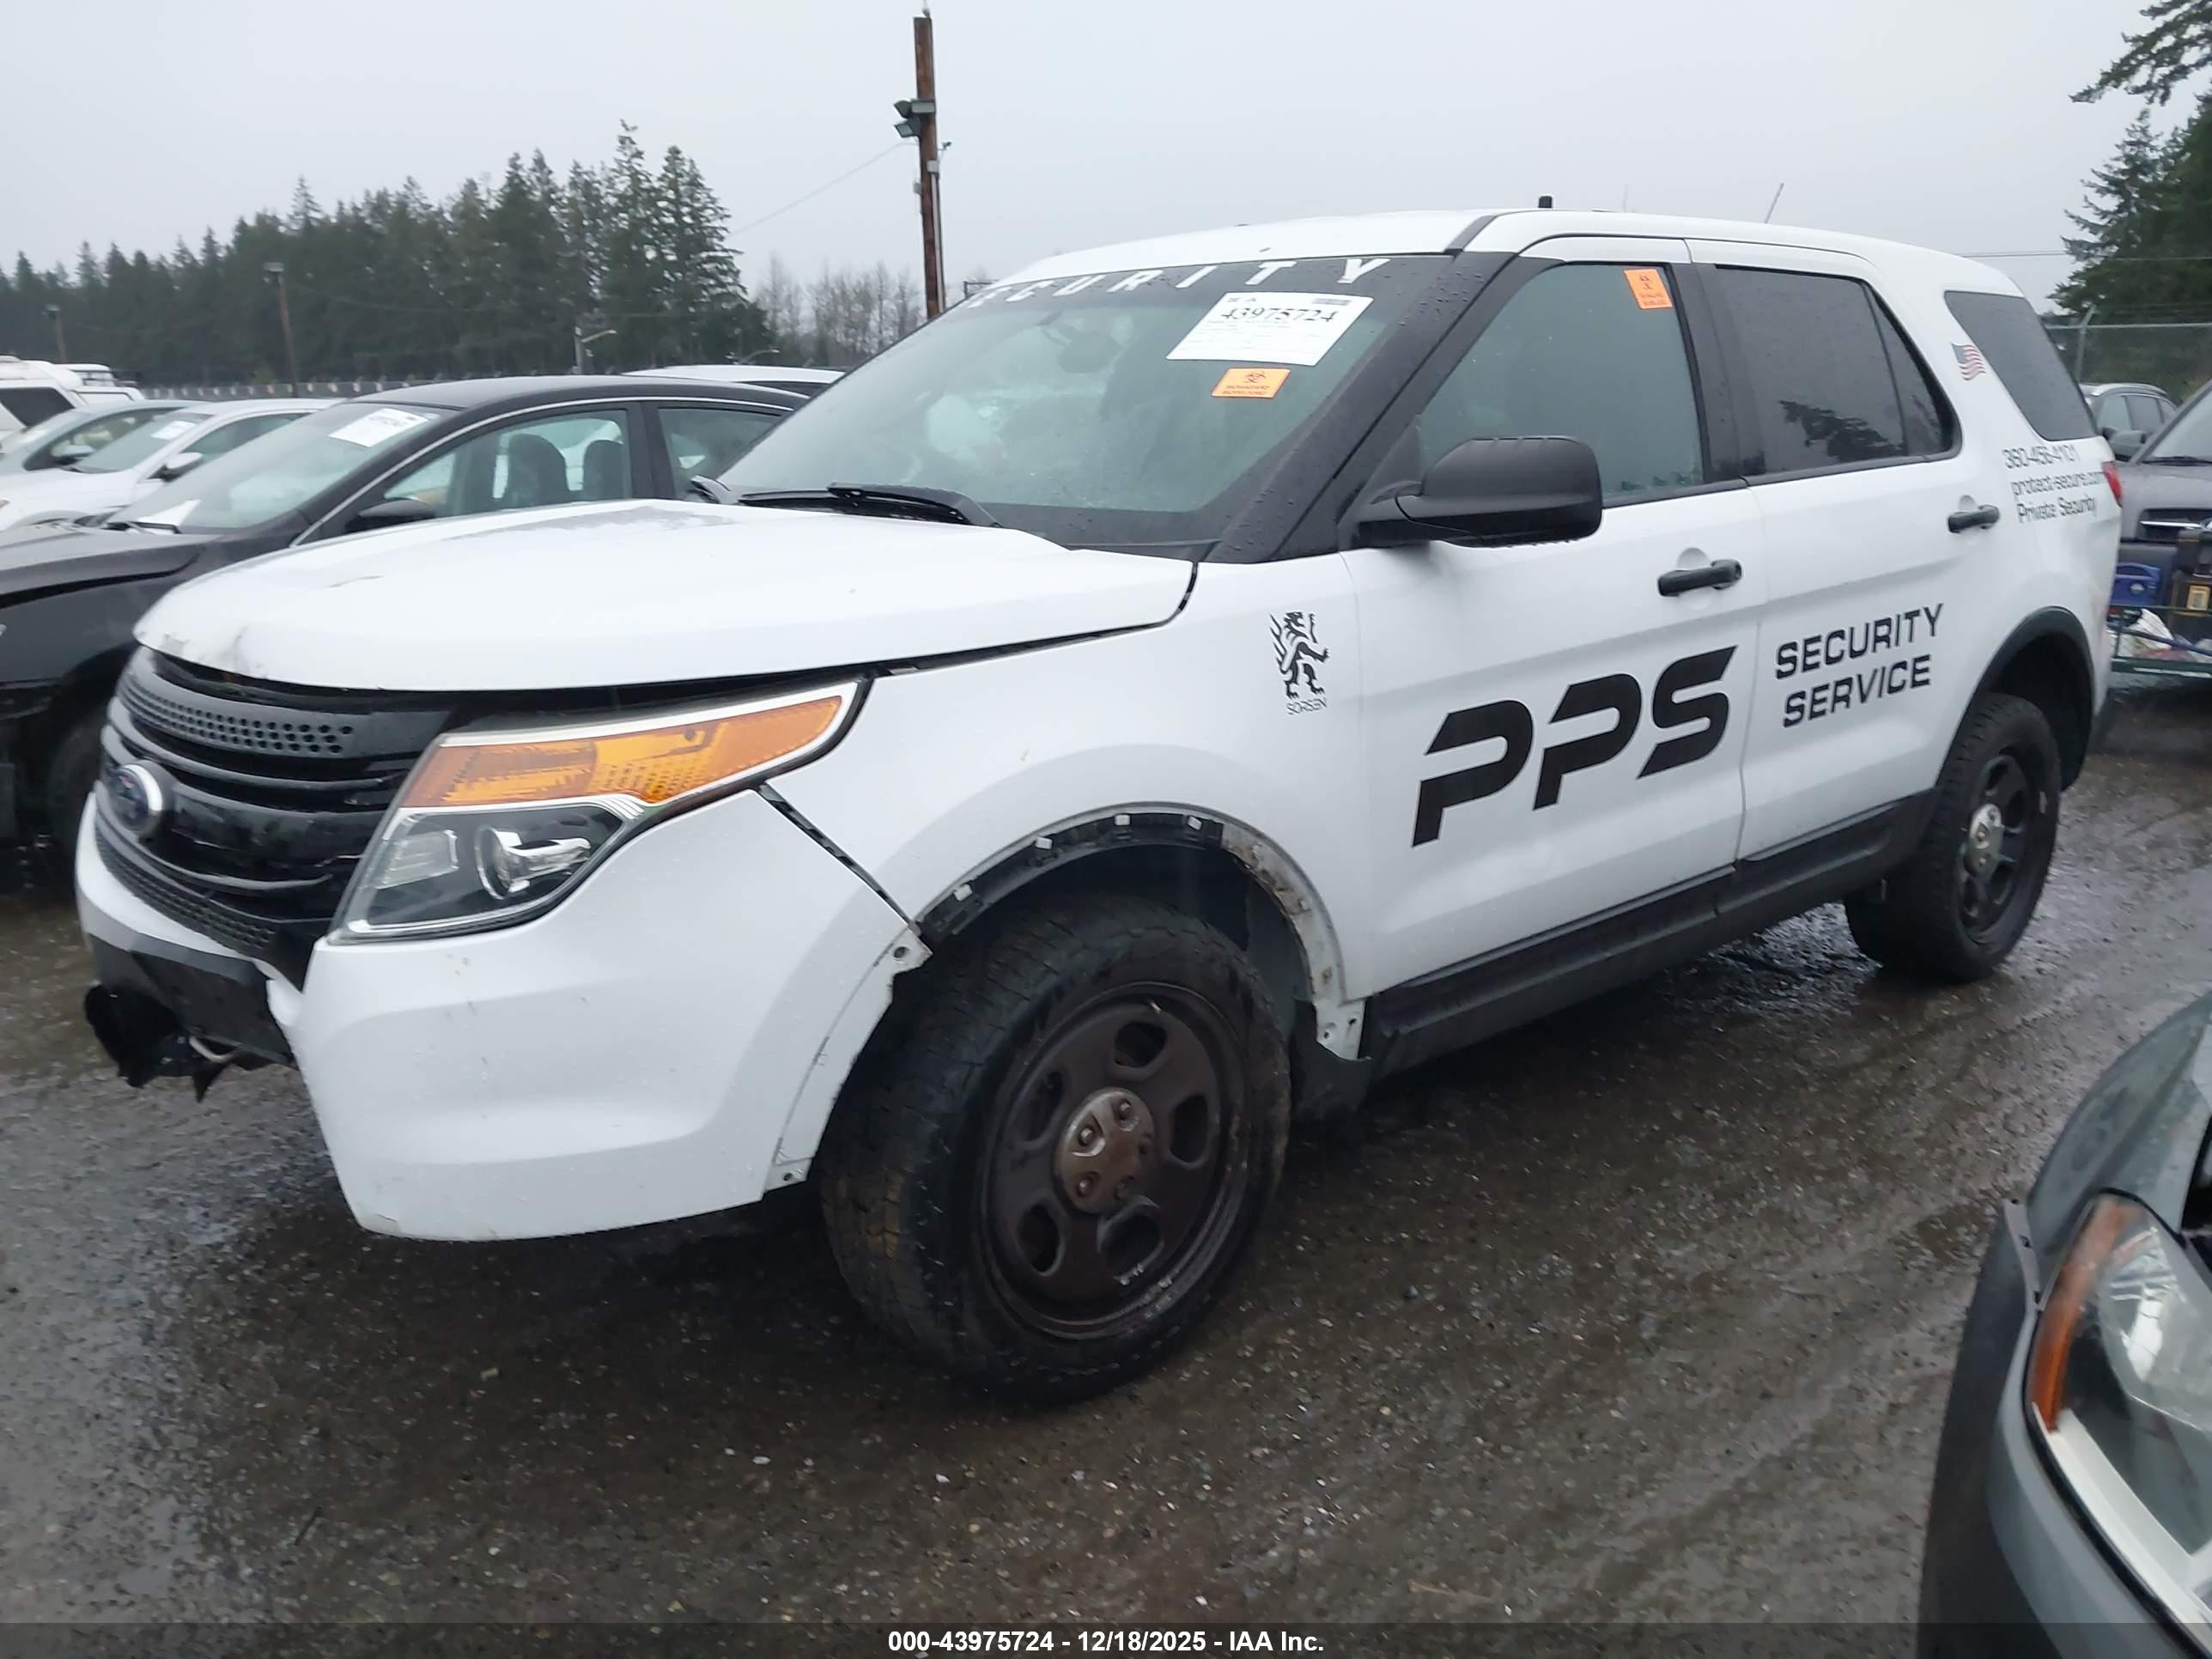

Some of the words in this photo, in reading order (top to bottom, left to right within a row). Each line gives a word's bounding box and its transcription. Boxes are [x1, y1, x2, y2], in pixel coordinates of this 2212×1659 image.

[1221, 307, 1340, 323] 43975724
[2017, 501, 2057, 523] Private
[2058, 495, 2097, 518] Security
[1776, 603, 1943, 679] SECURITY
[1783, 654, 1930, 727] SERVICE
[1412, 646, 1737, 848] PPS
